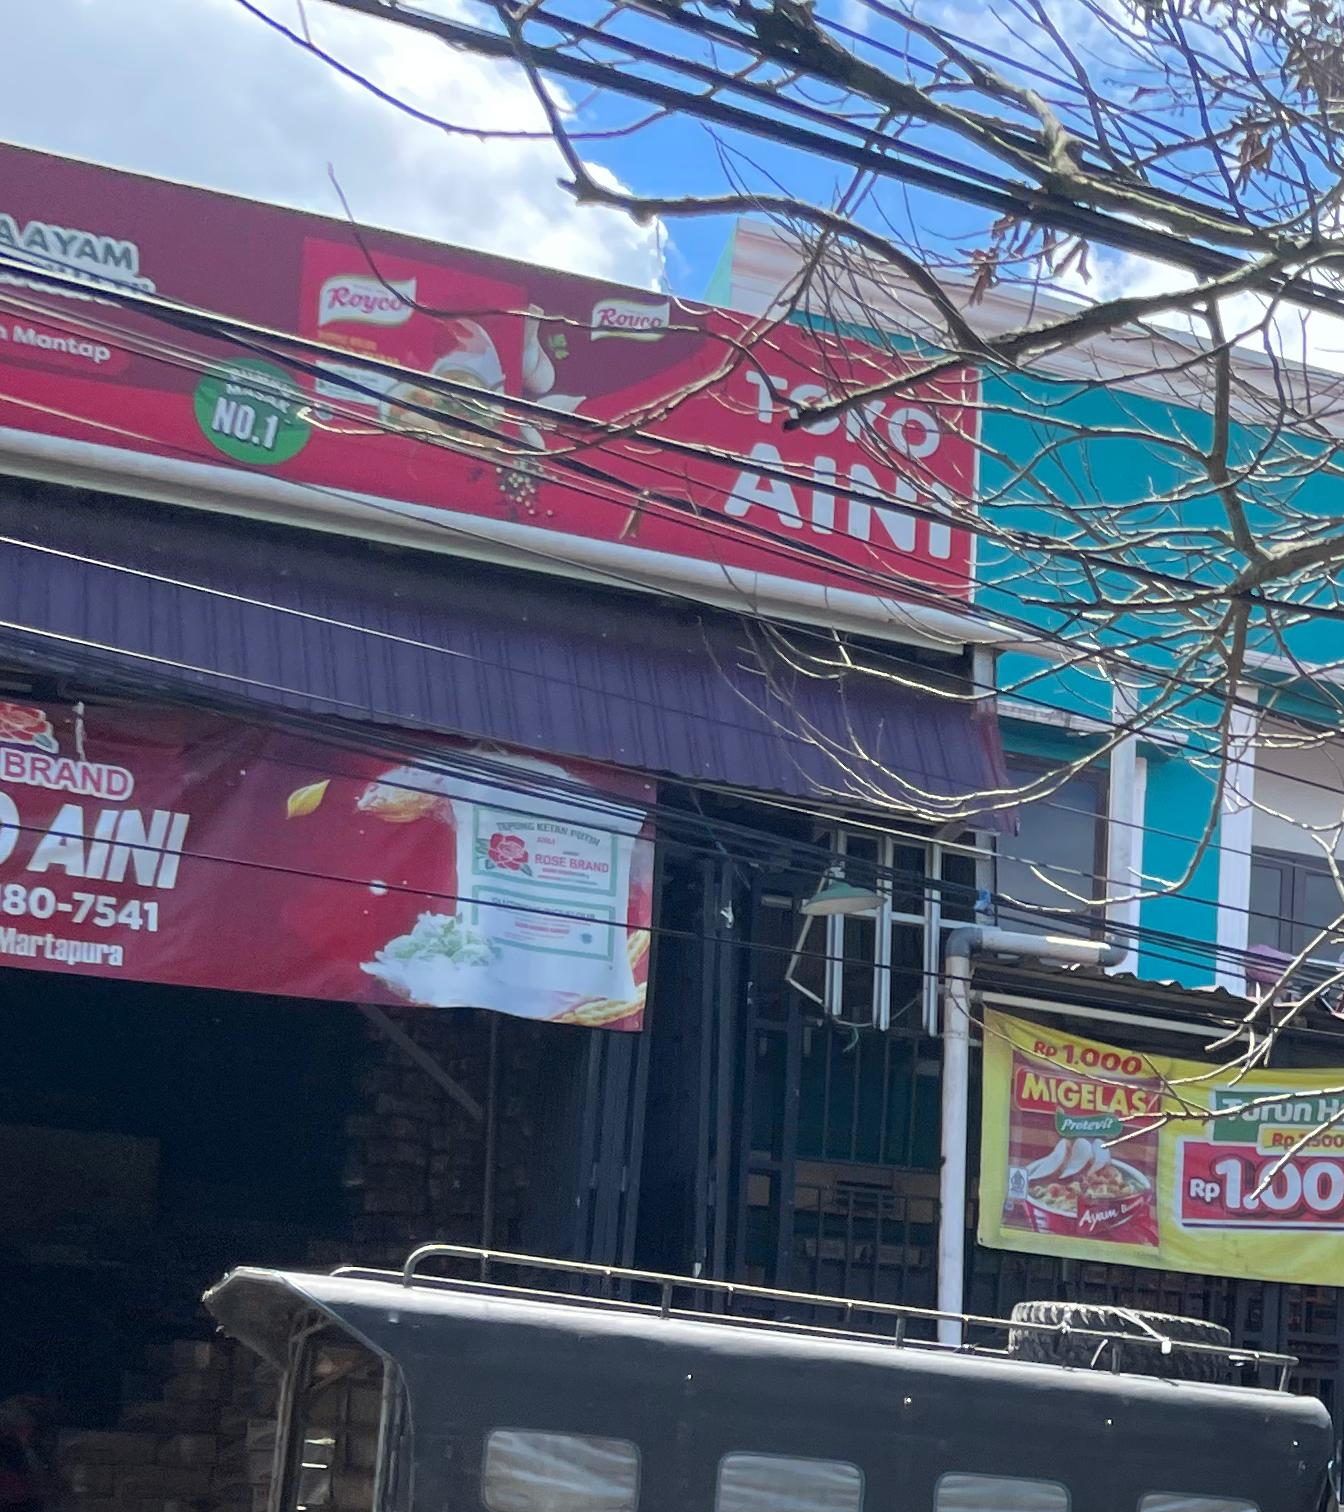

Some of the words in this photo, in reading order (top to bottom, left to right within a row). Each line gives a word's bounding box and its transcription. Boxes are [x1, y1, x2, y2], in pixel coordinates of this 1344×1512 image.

[25, 226, 134, 270] AYAM
[327, 286, 405, 313] Royco
[13, 326, 110, 364] Mantap
[211, 396, 279, 449] NO.1
[746, 370, 941, 459] TOKO
[724, 443, 951, 559] AINI
[4, 752, 129, 796] BRAND
[26, 804, 190, 889] AINI
[534, 854, 566, 868] ROSE
[569, 858, 609, 873] BRAND
[0, 883, 158, 932] 80-7541
[0, 927, 123, 967] Martapura
[1034, 1041, 1057, 1057] Rp
[1063, 1044, 1143, 1075] 1.000
[1022, 1073, 1147, 1117] MIGELAS
[1222, 1098, 1313, 1121] Turun
[1061, 1118, 1114, 1131] Protevit
[1272, 1132, 1295, 1151] Rp
[1190, 1178, 1221, 1201] Rp
